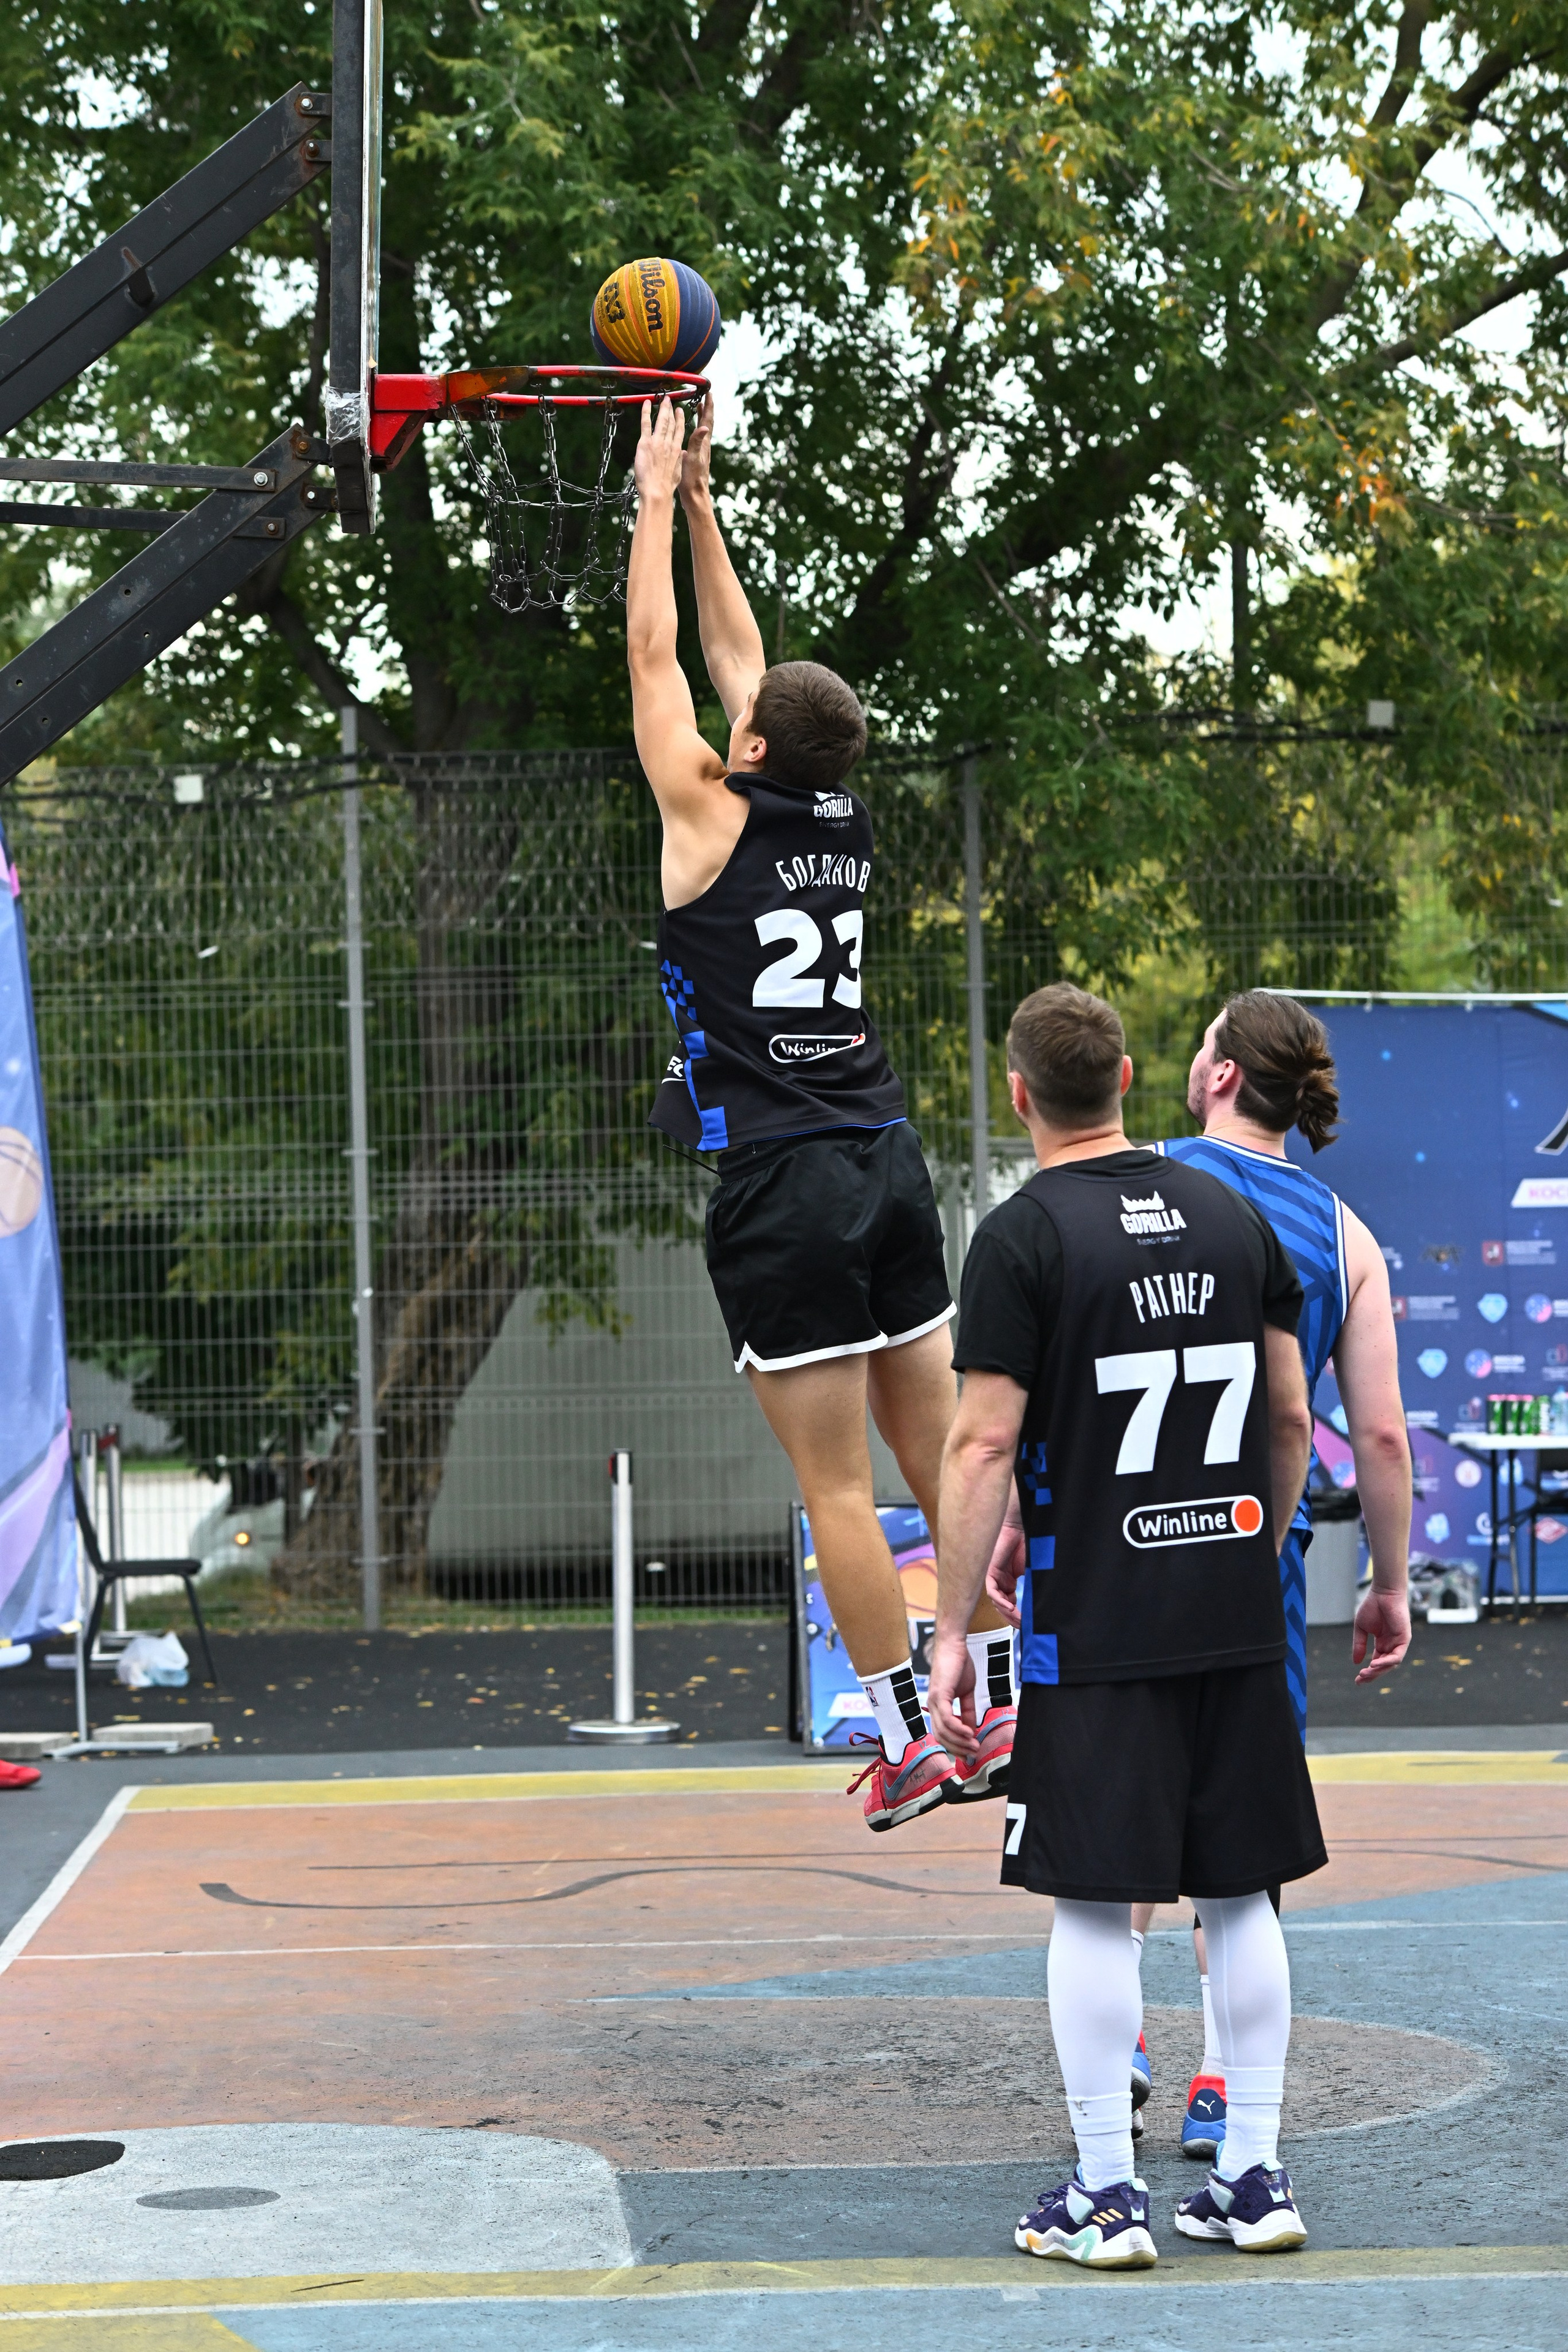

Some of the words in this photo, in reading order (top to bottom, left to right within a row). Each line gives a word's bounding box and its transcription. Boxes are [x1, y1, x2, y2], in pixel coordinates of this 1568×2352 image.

[638, 258, 665, 333] Wilson
[813, 797, 853, 818] GORILLA
[752, 908, 863, 1009] 23
[1120, 1208, 1187, 1234] GORILLA
[1129, 1272, 1215, 1323] РАТНЕР
[1095, 1341, 1256, 1476] 77
[1137, 1511, 1227, 1539] Winline
[1005, 1803, 1027, 1855] 7
